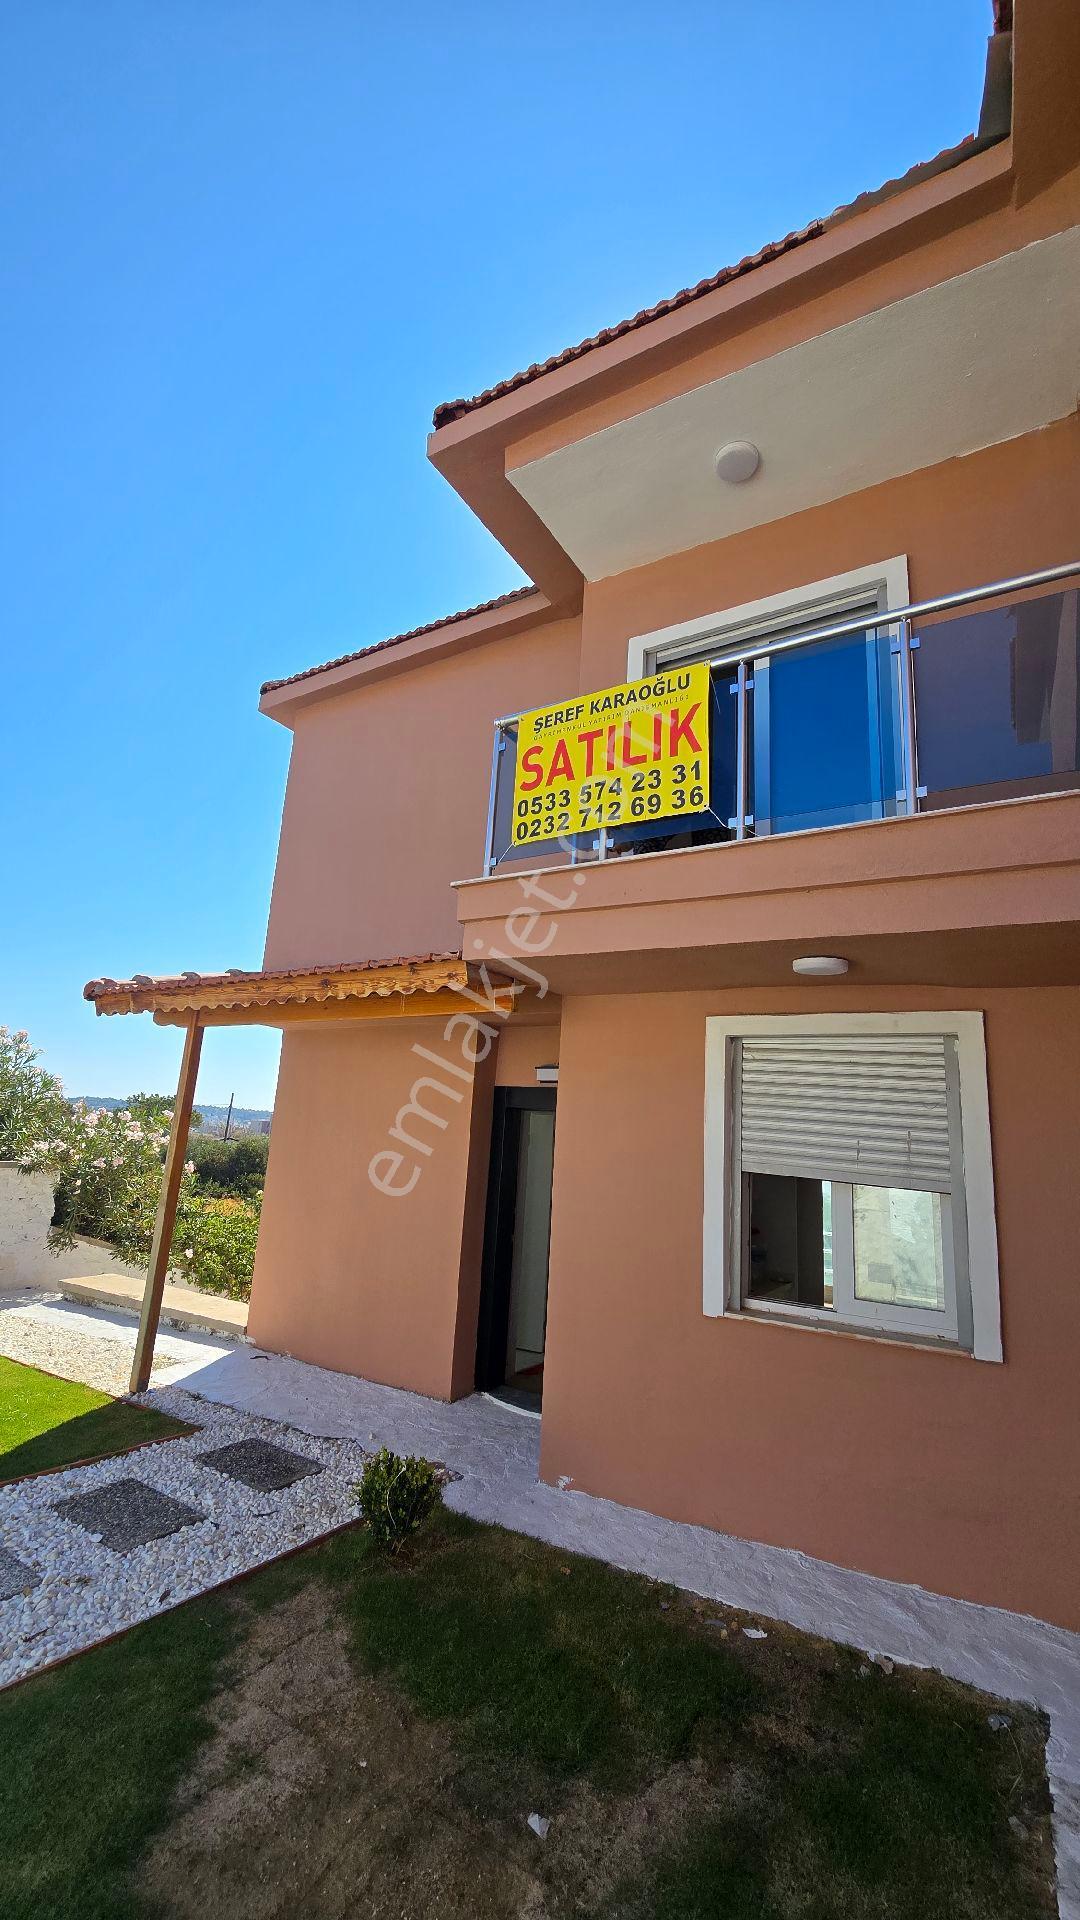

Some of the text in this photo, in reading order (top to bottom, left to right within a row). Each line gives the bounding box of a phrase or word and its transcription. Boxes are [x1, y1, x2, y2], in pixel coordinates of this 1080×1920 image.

[533, 672, 691, 734] ŞEREF KARAOĞLU
[519, 702, 703, 792] SATILIK
[516, 785, 704, 841] 0232 712 69 36
[517, 760, 701, 818] 0533 574 23 31
